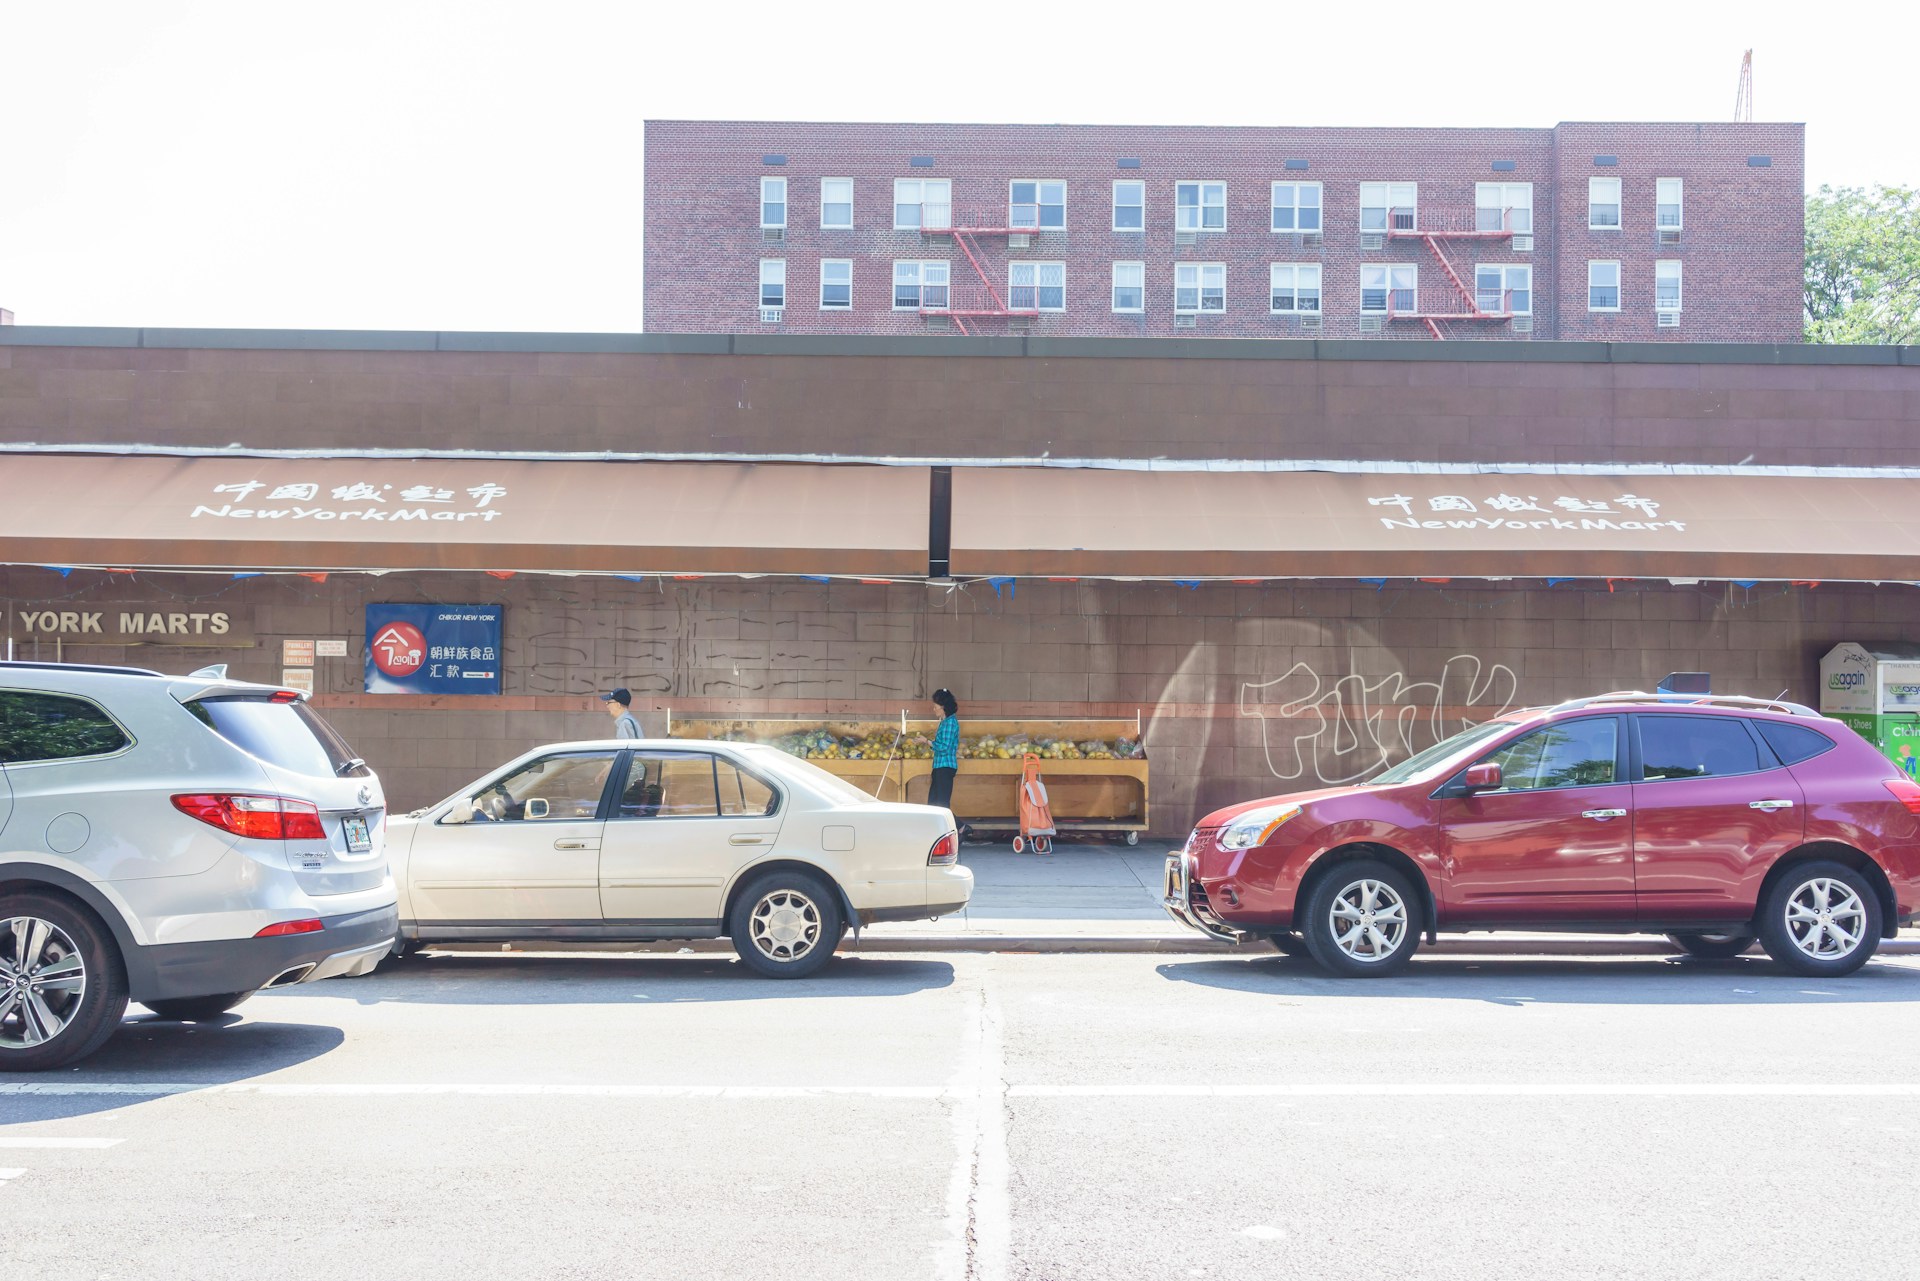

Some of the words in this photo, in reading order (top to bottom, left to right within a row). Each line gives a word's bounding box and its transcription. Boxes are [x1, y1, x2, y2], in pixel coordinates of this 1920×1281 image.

[19, 611, 104, 633] YORK
[119, 612, 230, 634] MARTS
[479, 614, 496, 622] YORK
[430, 646, 495, 660] 朝鲜族食品
[1854, 719, 1873, 730] Shoes
